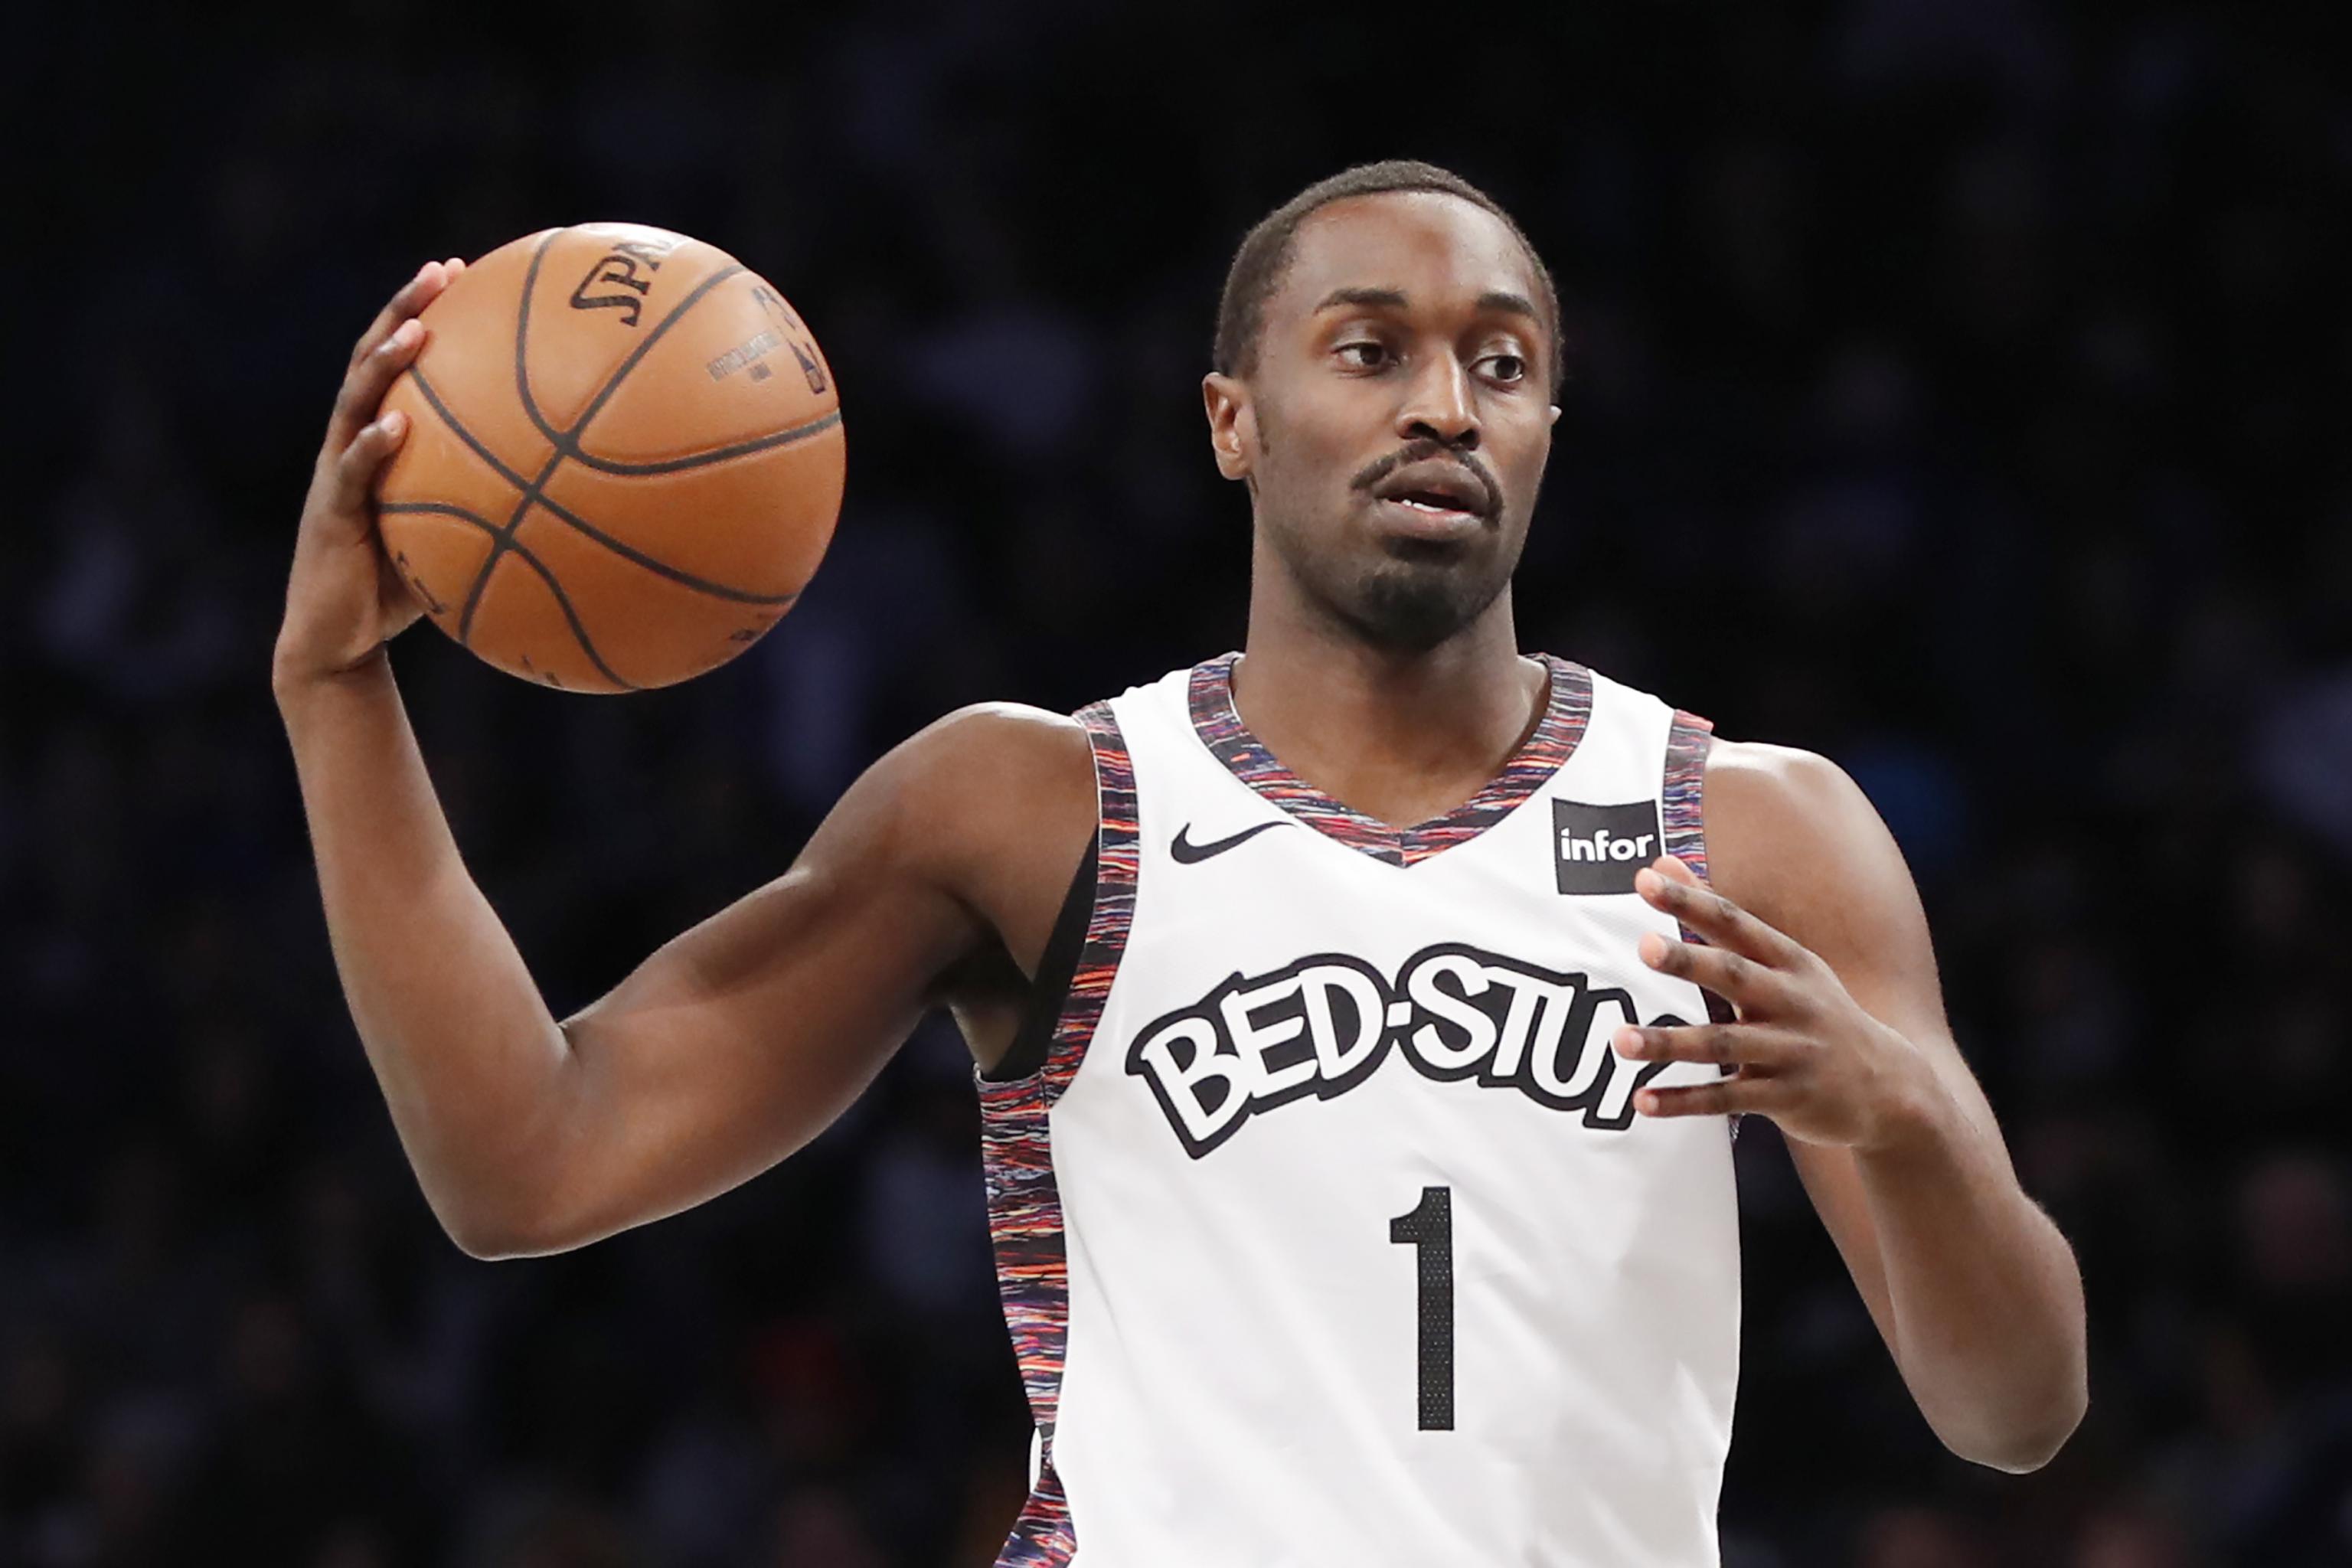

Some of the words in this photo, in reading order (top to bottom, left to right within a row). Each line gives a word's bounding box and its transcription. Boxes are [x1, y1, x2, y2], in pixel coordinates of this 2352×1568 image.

[1560, 827, 1655, 861] infor
[1125, 942, 1694, 1160] BED-STUY
[1390, 1186, 1455, 1431] 1
